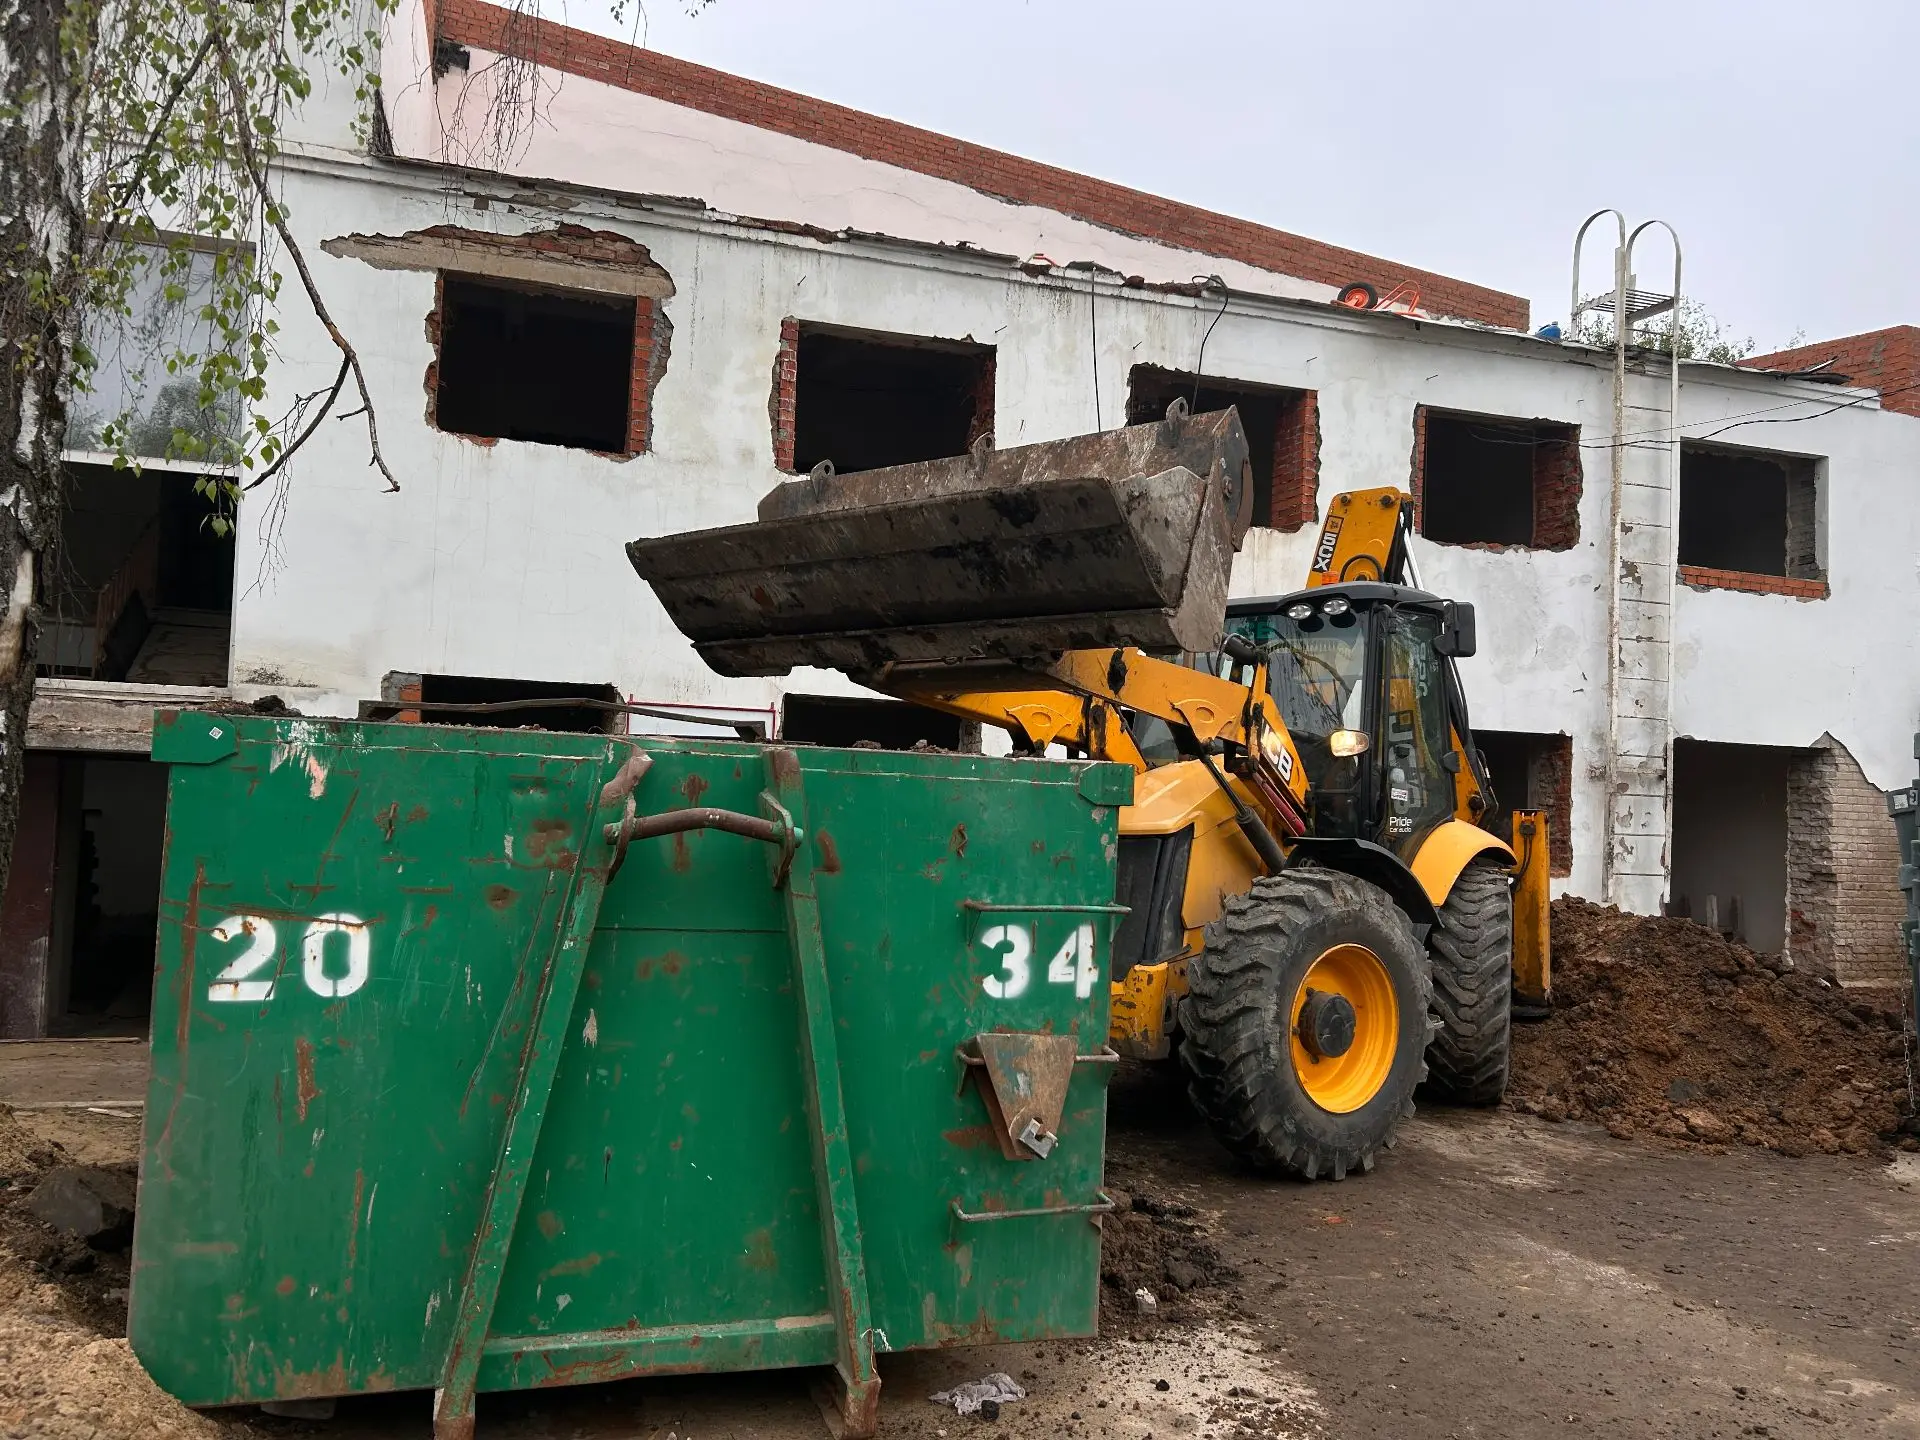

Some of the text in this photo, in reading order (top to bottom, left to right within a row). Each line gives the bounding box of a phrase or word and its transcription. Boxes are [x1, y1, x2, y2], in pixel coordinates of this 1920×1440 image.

[1313, 533, 1338, 571] 5CX
[1389, 816, 1413, 827] Pride
[208, 911, 370, 1001] 20
[980, 924, 1099, 999] 34
